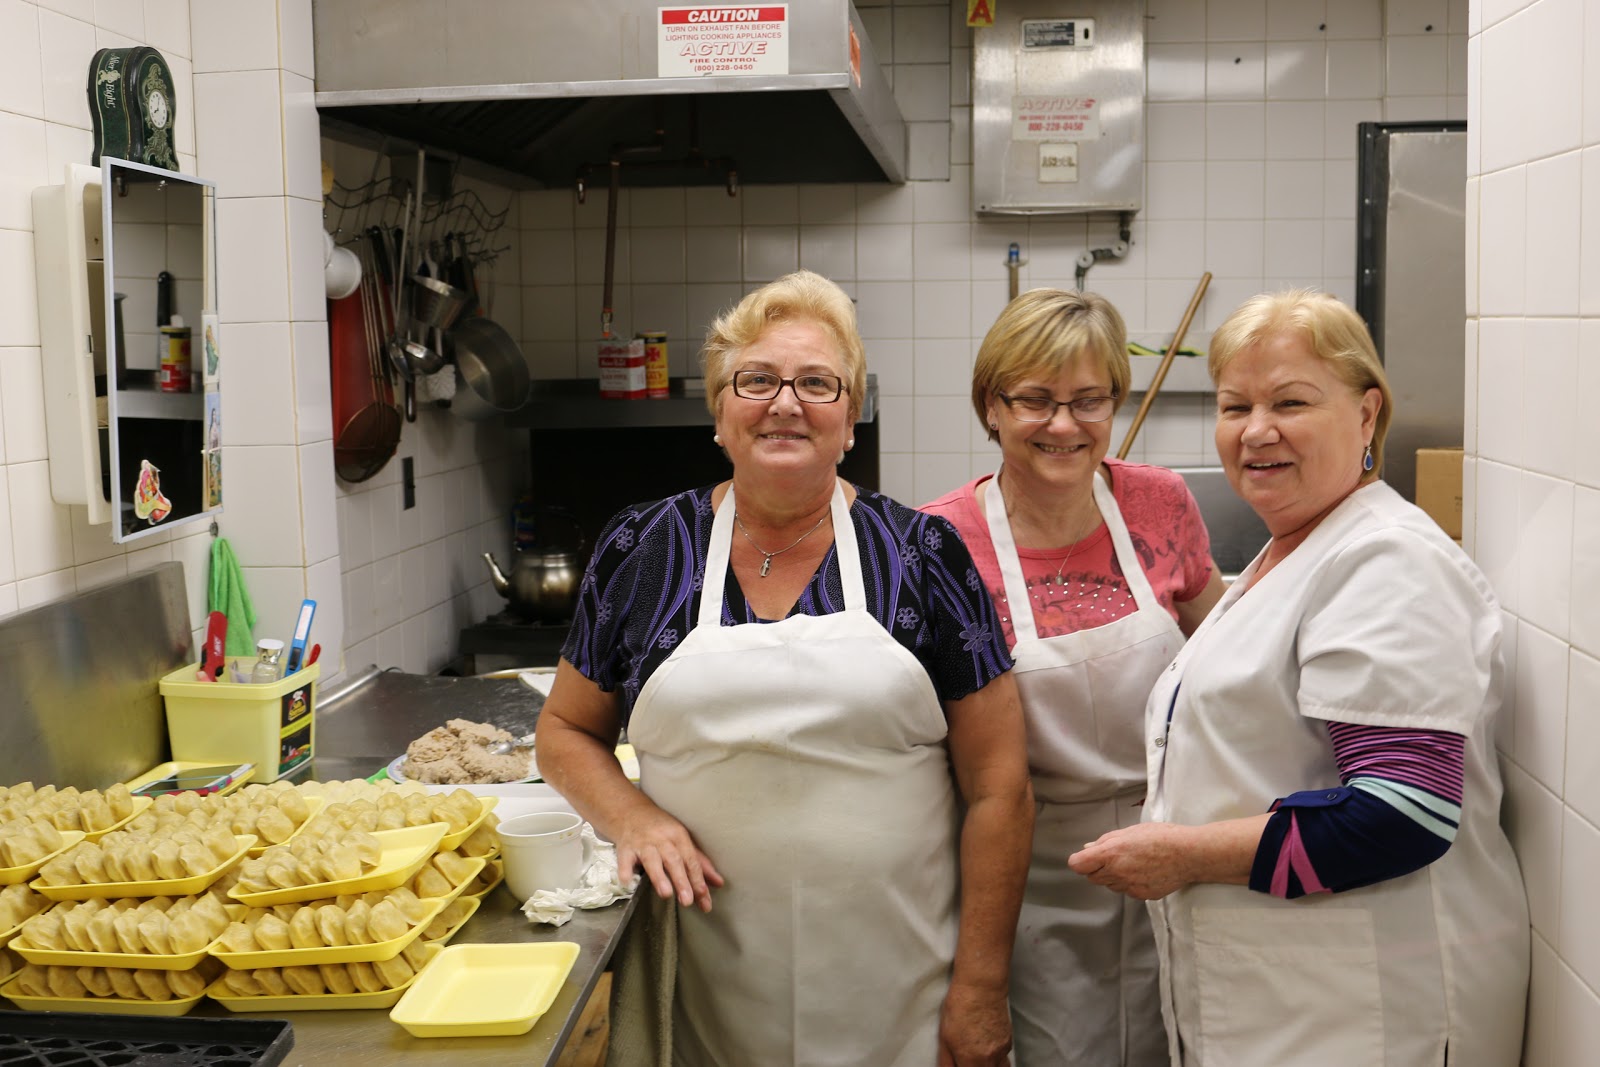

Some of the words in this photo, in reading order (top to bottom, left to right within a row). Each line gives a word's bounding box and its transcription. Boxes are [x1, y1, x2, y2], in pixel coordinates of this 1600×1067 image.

[688, 9, 760, 23] CAUTION
[969, 0, 993, 24] A
[751, 23, 781, 31] BEFORE
[665, 34, 699, 42] LIGHTING
[700, 33, 735, 41] COOKING
[736, 32, 782, 40] APPLIANCES
[680, 41, 768, 57] ACTIVE
[104, 83, 116, 107] Eight
